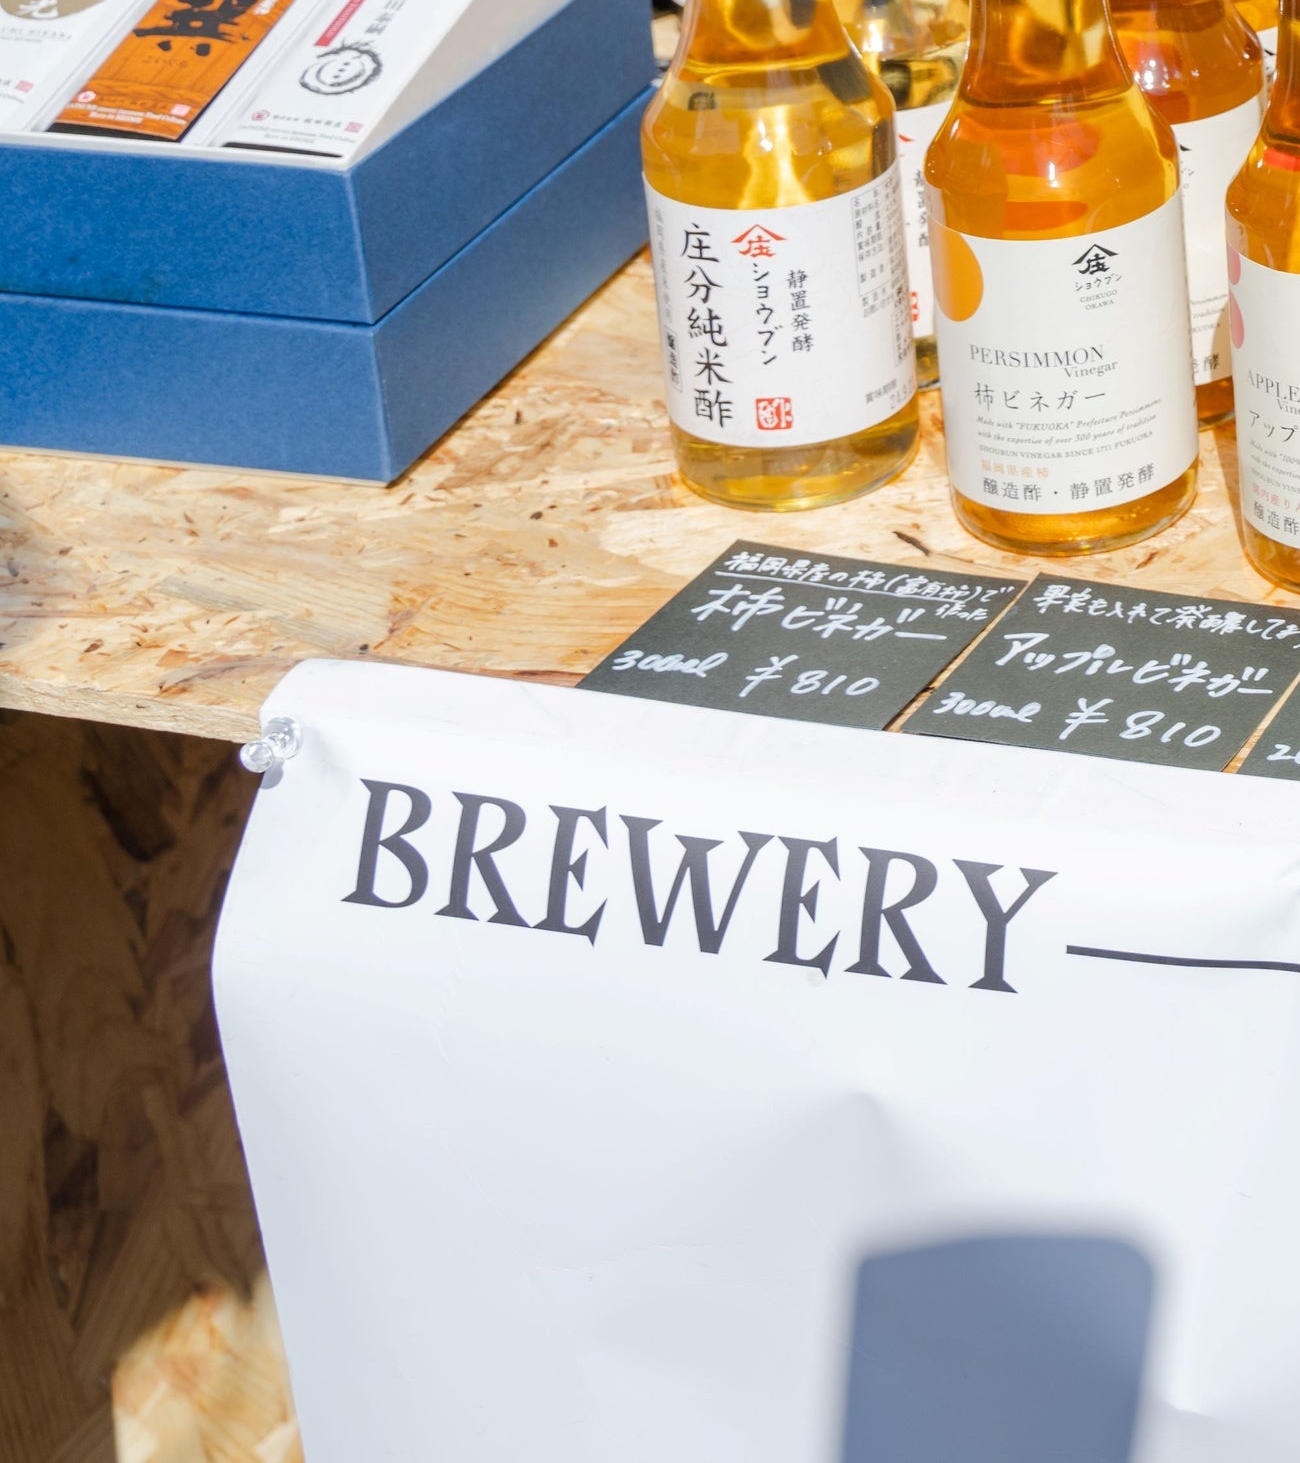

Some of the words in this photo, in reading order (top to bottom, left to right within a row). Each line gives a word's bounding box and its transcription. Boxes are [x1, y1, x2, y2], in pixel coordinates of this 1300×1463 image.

[1074, 273, 1122, 292] ショウブン
[1079, 289, 1118, 303] CHIKUGO
[752, 262, 784, 366] ショウブン
[786, 268, 815, 353] 静置発酵
[1084, 299, 1115, 311] OKAWA
[680, 222, 734, 428] 庄分純米酢
[968, 343, 1105, 369] PERSIMMON
[1063, 360, 1118, 379] Vinegar
[972, 381, 1107, 413] 柿ビネガー
[1247, 369, 1300, 403] APPLE
[1020, 448, 1063, 459] VINEGAR
[1064, 447, 1094, 458] SINCE
[1114, 430, 1154, 449] FUKUOKA
[982, 463, 1155, 501] 醸造酢・静置発酵
[690, 582, 948, 642] 柿ビネガー
[738, 653, 881, 698] ¥810
[995, 631, 1274, 698] アップルビネガー
[932, 690, 1042, 724] 300ml
[1058, 697, 1223, 748] ¥810
[340, 778, 1059, 994] BREWERY
